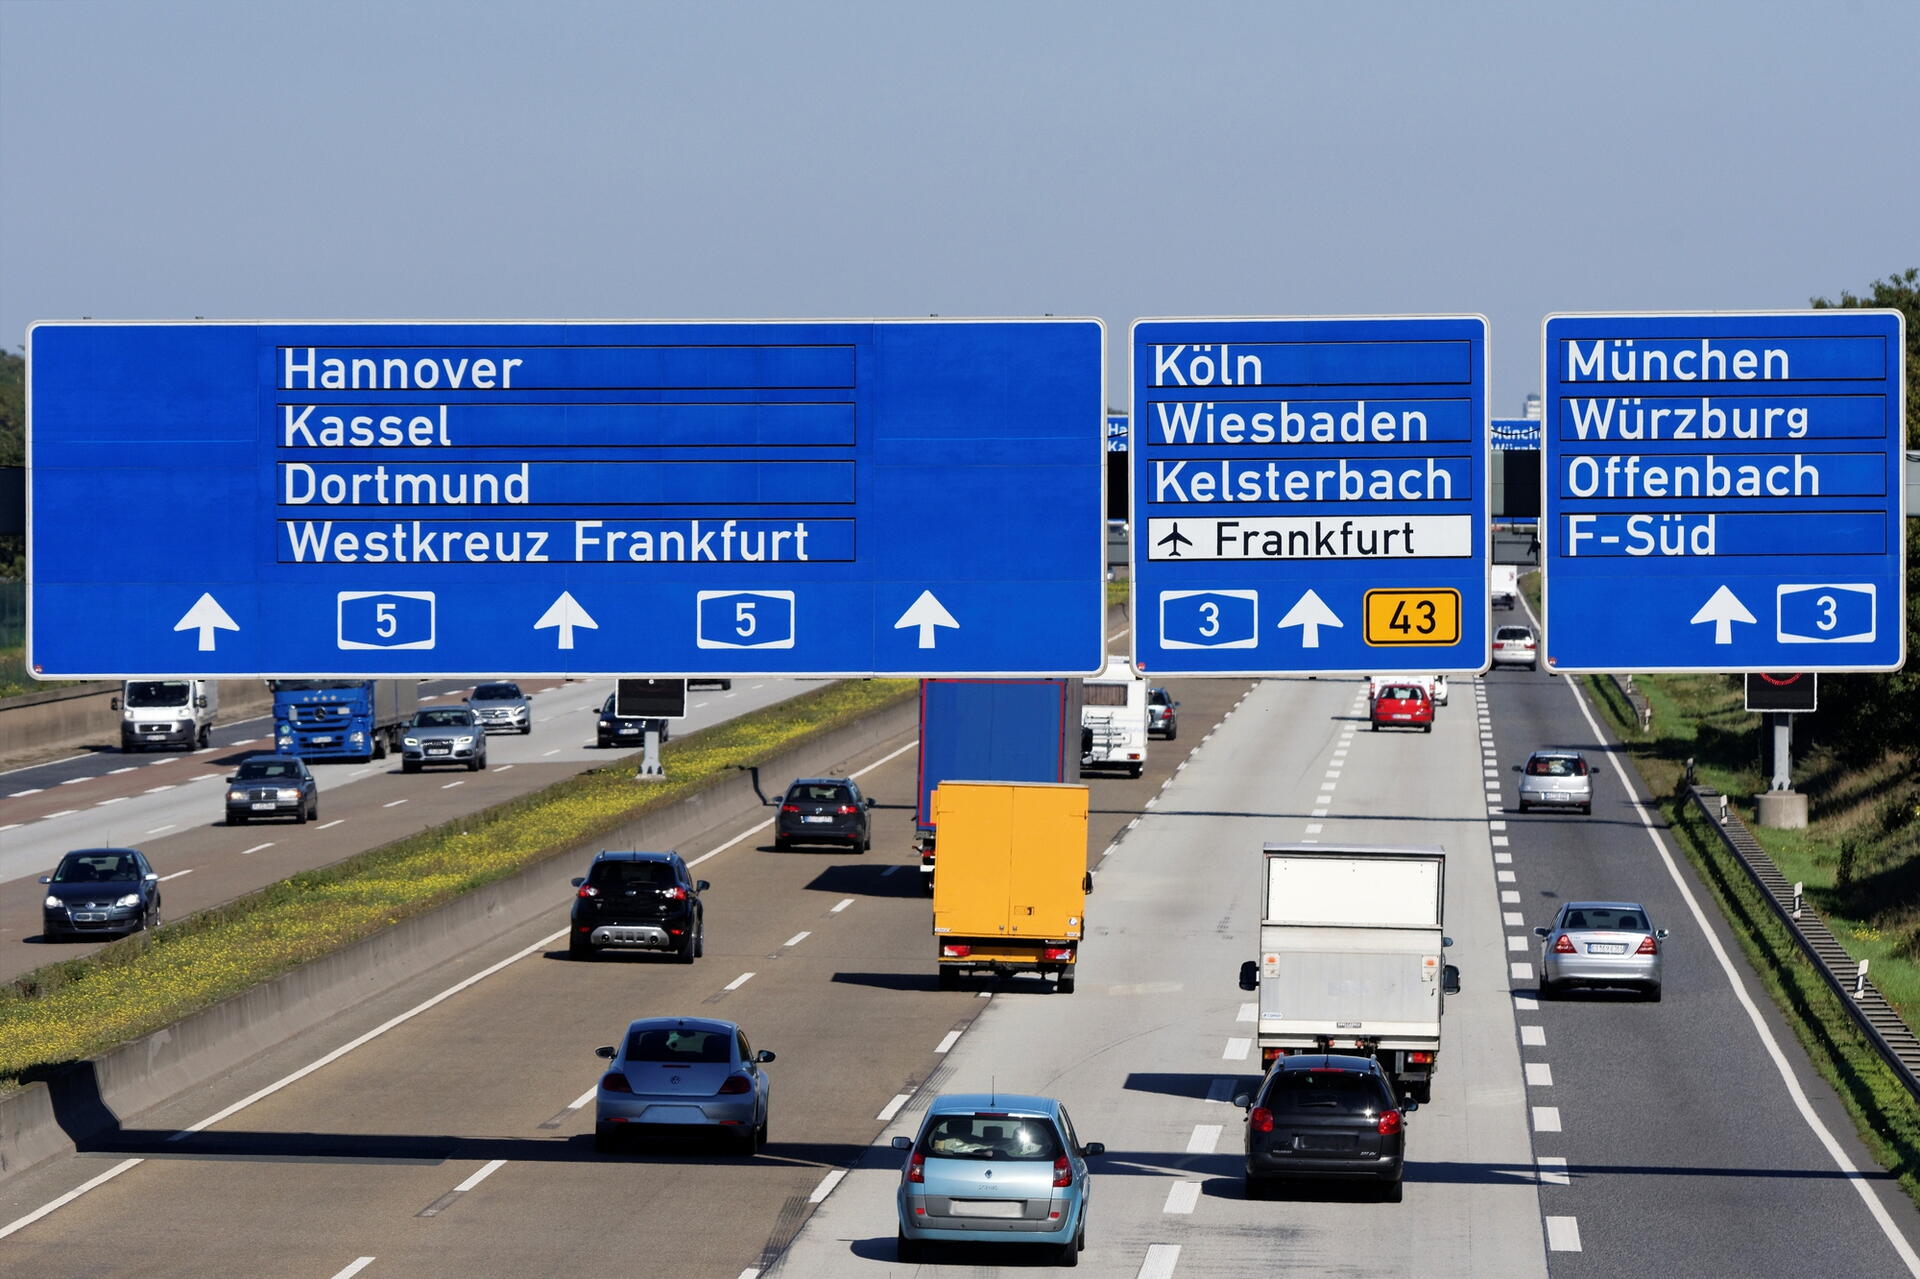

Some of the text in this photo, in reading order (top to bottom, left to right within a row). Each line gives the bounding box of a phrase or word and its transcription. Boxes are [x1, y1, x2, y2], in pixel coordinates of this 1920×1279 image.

[285, 348, 523, 389] Hannover
[1156, 343, 1262, 386] Köln
[1569, 339, 1789, 382] München
[286, 404, 452, 447] Kassel
[1157, 402, 1427, 443] Wiesbaden
[1569, 398, 1808, 439] Würzburg
[285, 463, 529, 505] Dortmund
[1157, 460, 1452, 503] Kelsterbach
[1569, 456, 1819, 498] Offenbach
[287, 520, 809, 563] Westkreuz Frankfurt
[1217, 520, 1415, 556] Frankfurt
[1570, 514, 1716, 557] F-Süd
[376, 603, 397, 638] 5
[735, 602, 756, 637] 5
[1199, 601, 1220, 637] 3
[1389, 600, 1436, 635] 43
[1816, 595, 1837, 631] 3
